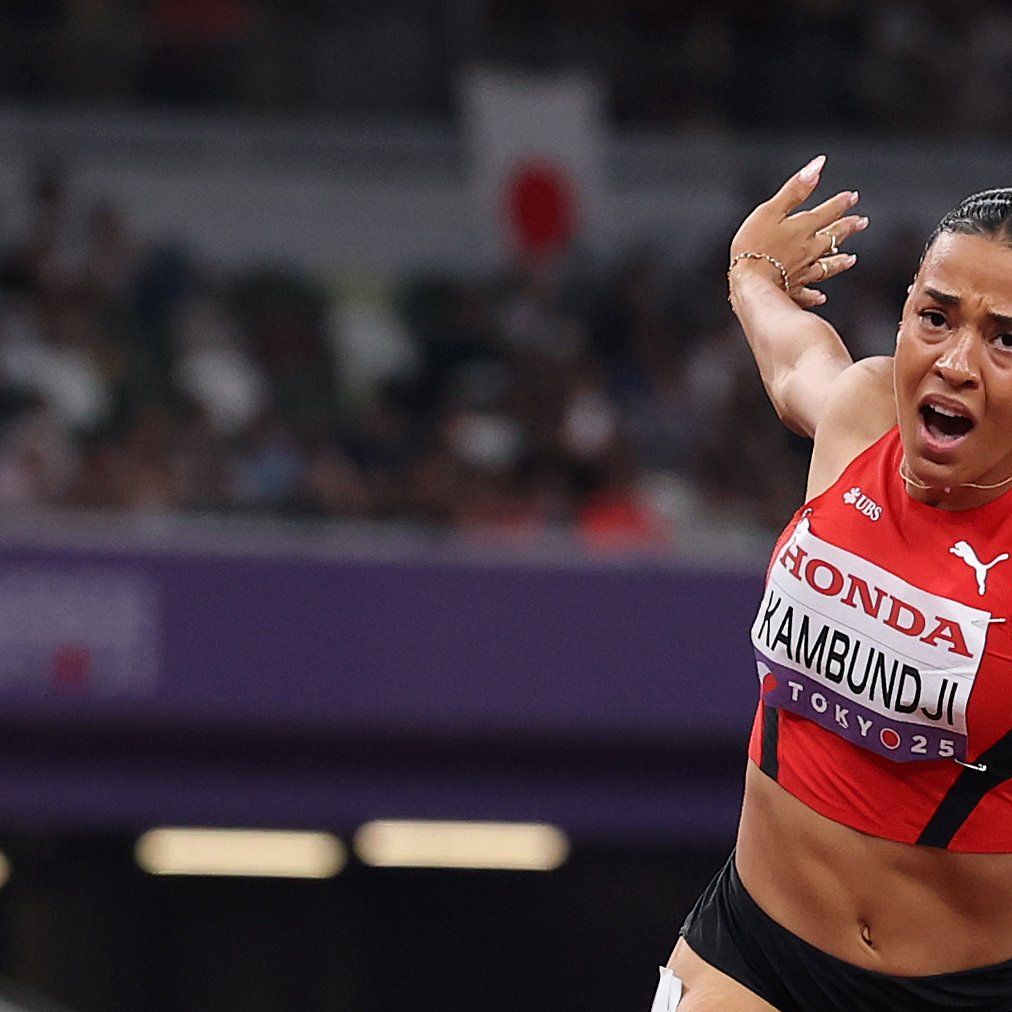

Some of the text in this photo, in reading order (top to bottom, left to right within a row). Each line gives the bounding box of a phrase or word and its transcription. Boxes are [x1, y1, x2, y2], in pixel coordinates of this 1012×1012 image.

[856, 495, 882, 521] UBS
[757, 590, 959, 725] KAMBUNDJI
[780, 543, 974, 658] HONDA
